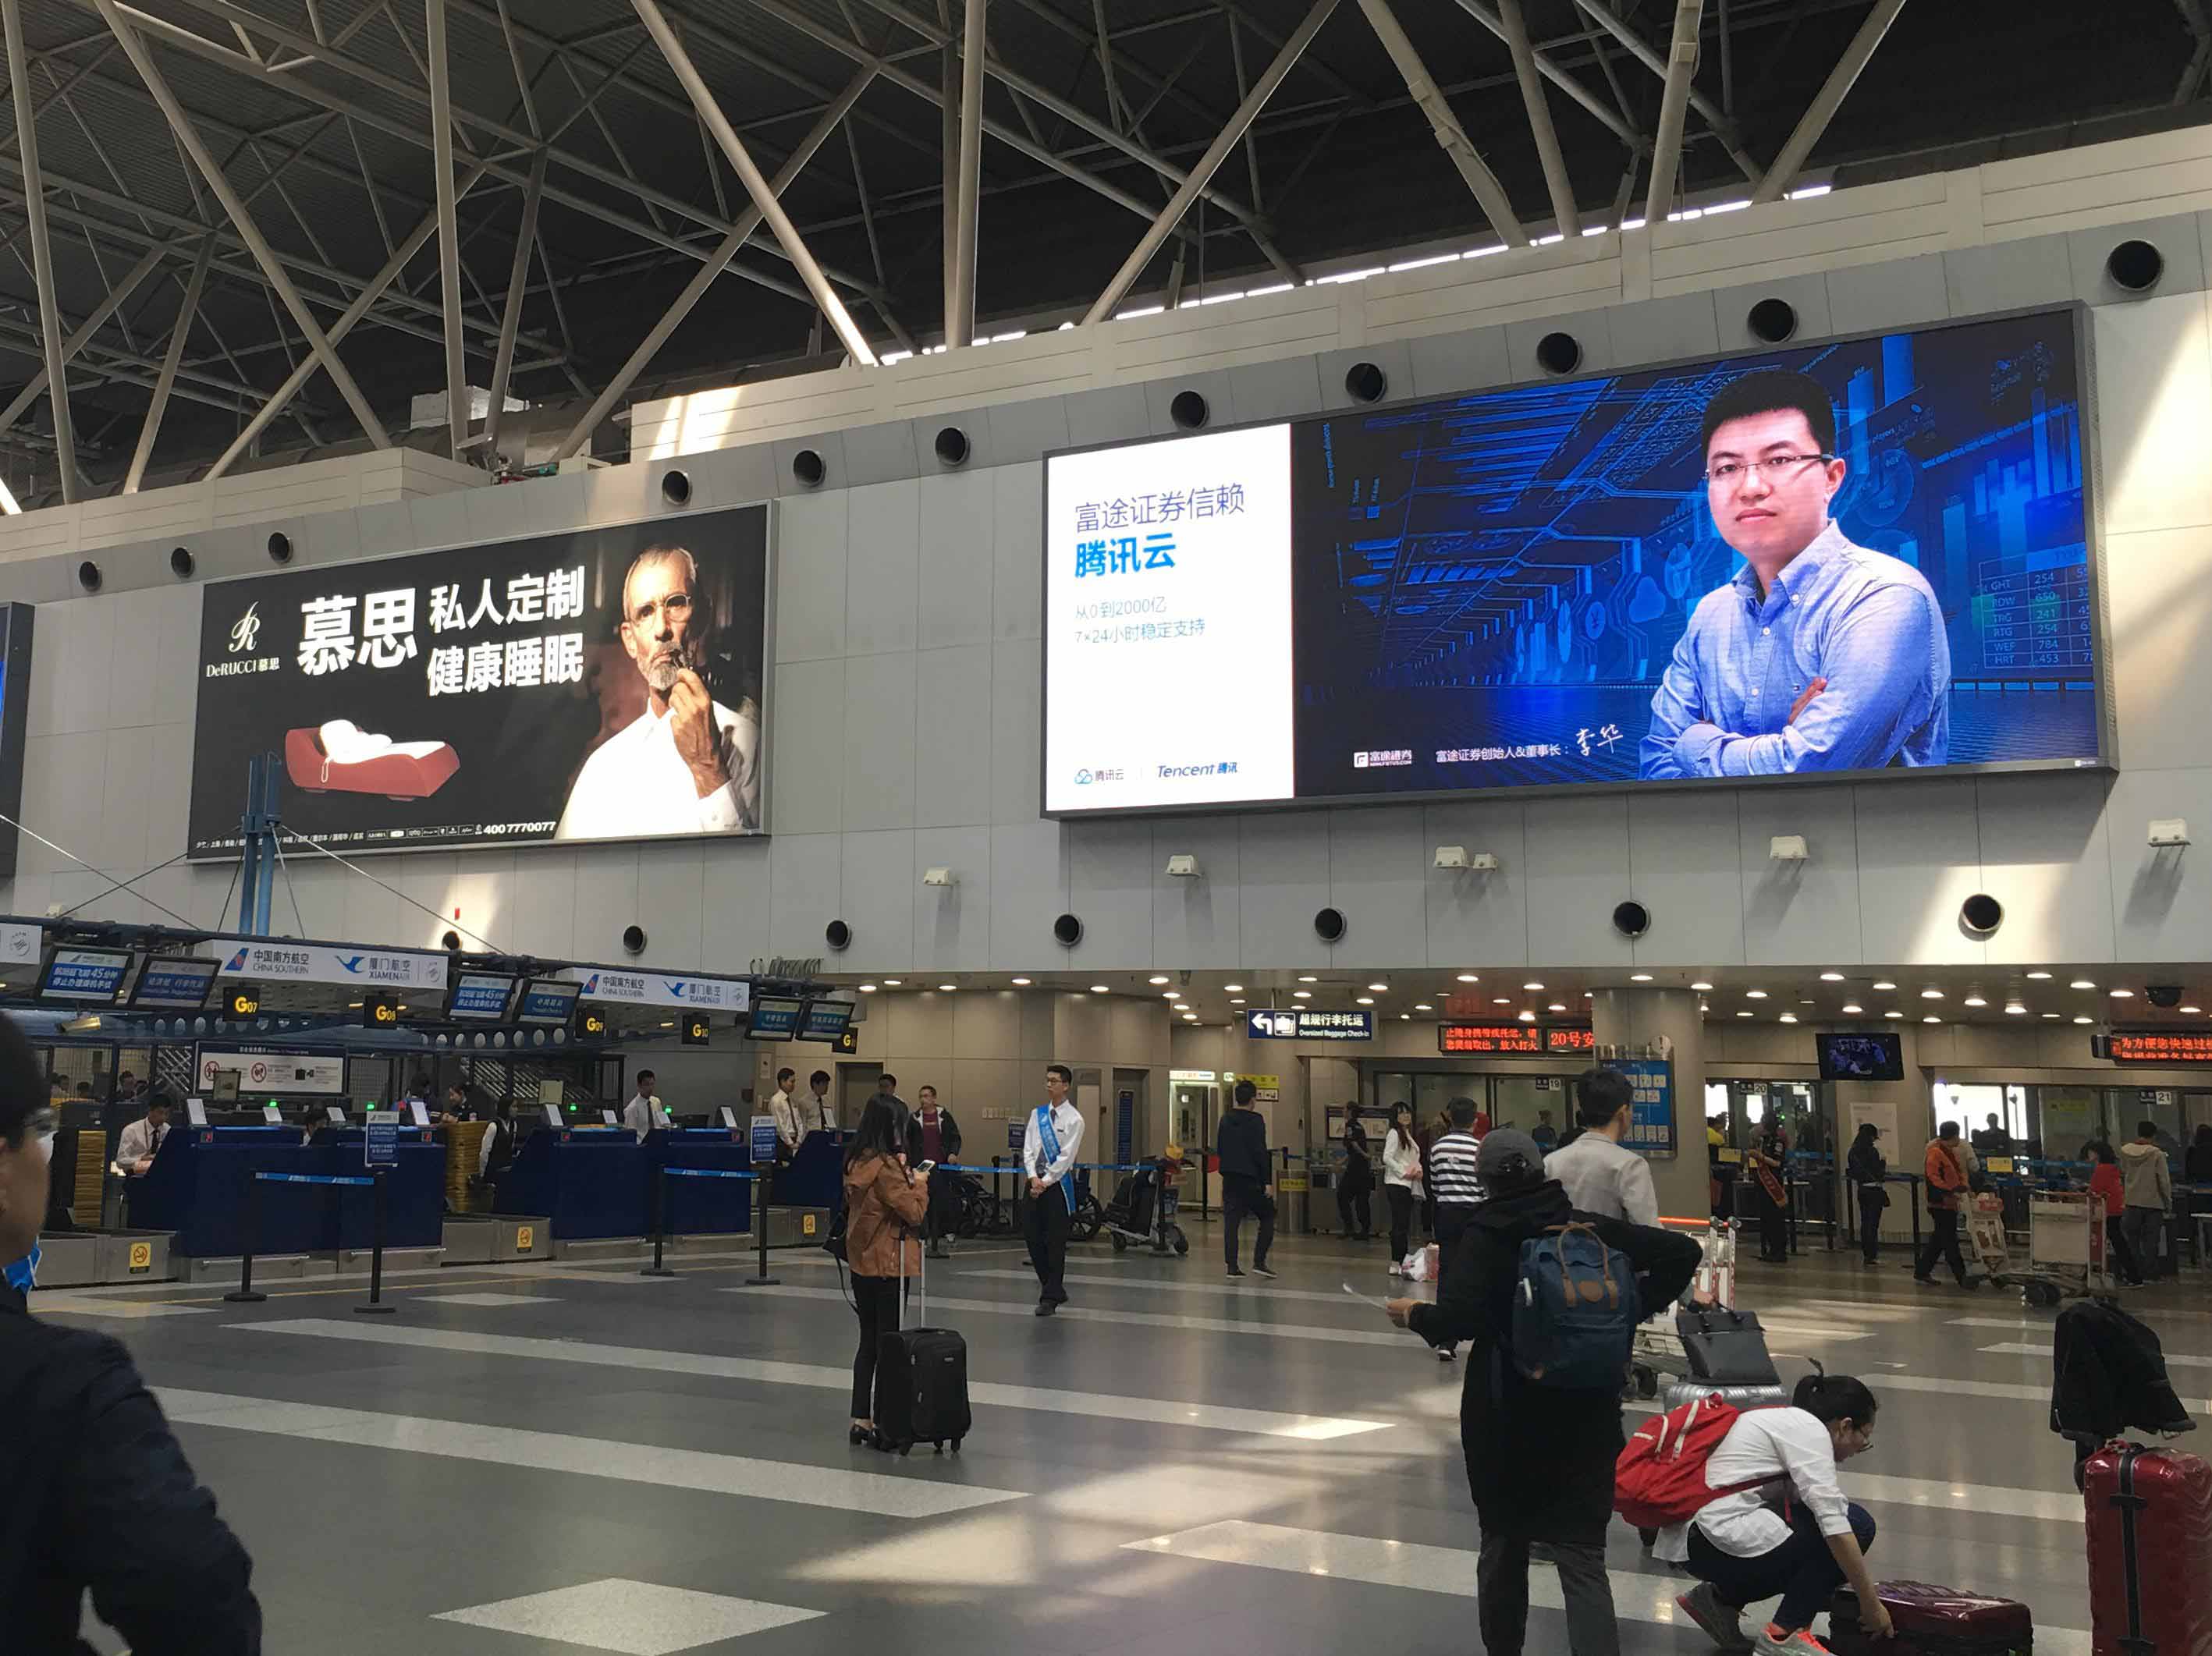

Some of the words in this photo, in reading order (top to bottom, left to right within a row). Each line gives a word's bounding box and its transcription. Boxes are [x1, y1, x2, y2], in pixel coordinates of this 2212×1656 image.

[1075, 483, 1244, 534] 富途证券信赖
[1074, 533, 1177, 578] 腾讯云
[429, 566, 585, 633] 私人定制
[1075, 597, 1167, 620] 从0到2000亿
[297, 587, 418, 676] 慕思
[206, 660, 256, 677] DeRUCCI
[427, 633, 584, 697] 健康睡眠
[1095, 769, 1124, 782] 腾讯云
[1158, 764, 1216, 778] Tencent
[1217, 762, 1238, 775] 腾讯
[484, 824, 506, 835] 400
[507, 821, 556, 833] 7770077
[254, 949, 310, 965] 中国南方航空
[369, 957, 411, 972] 厦门航空
[235, 996, 258, 1013] G07
[1299, 1013, 1364, 1027] 超规行李托运
[1756, 1084, 1767, 1094] 20
[2157, 1092, 2171, 1101] 21
